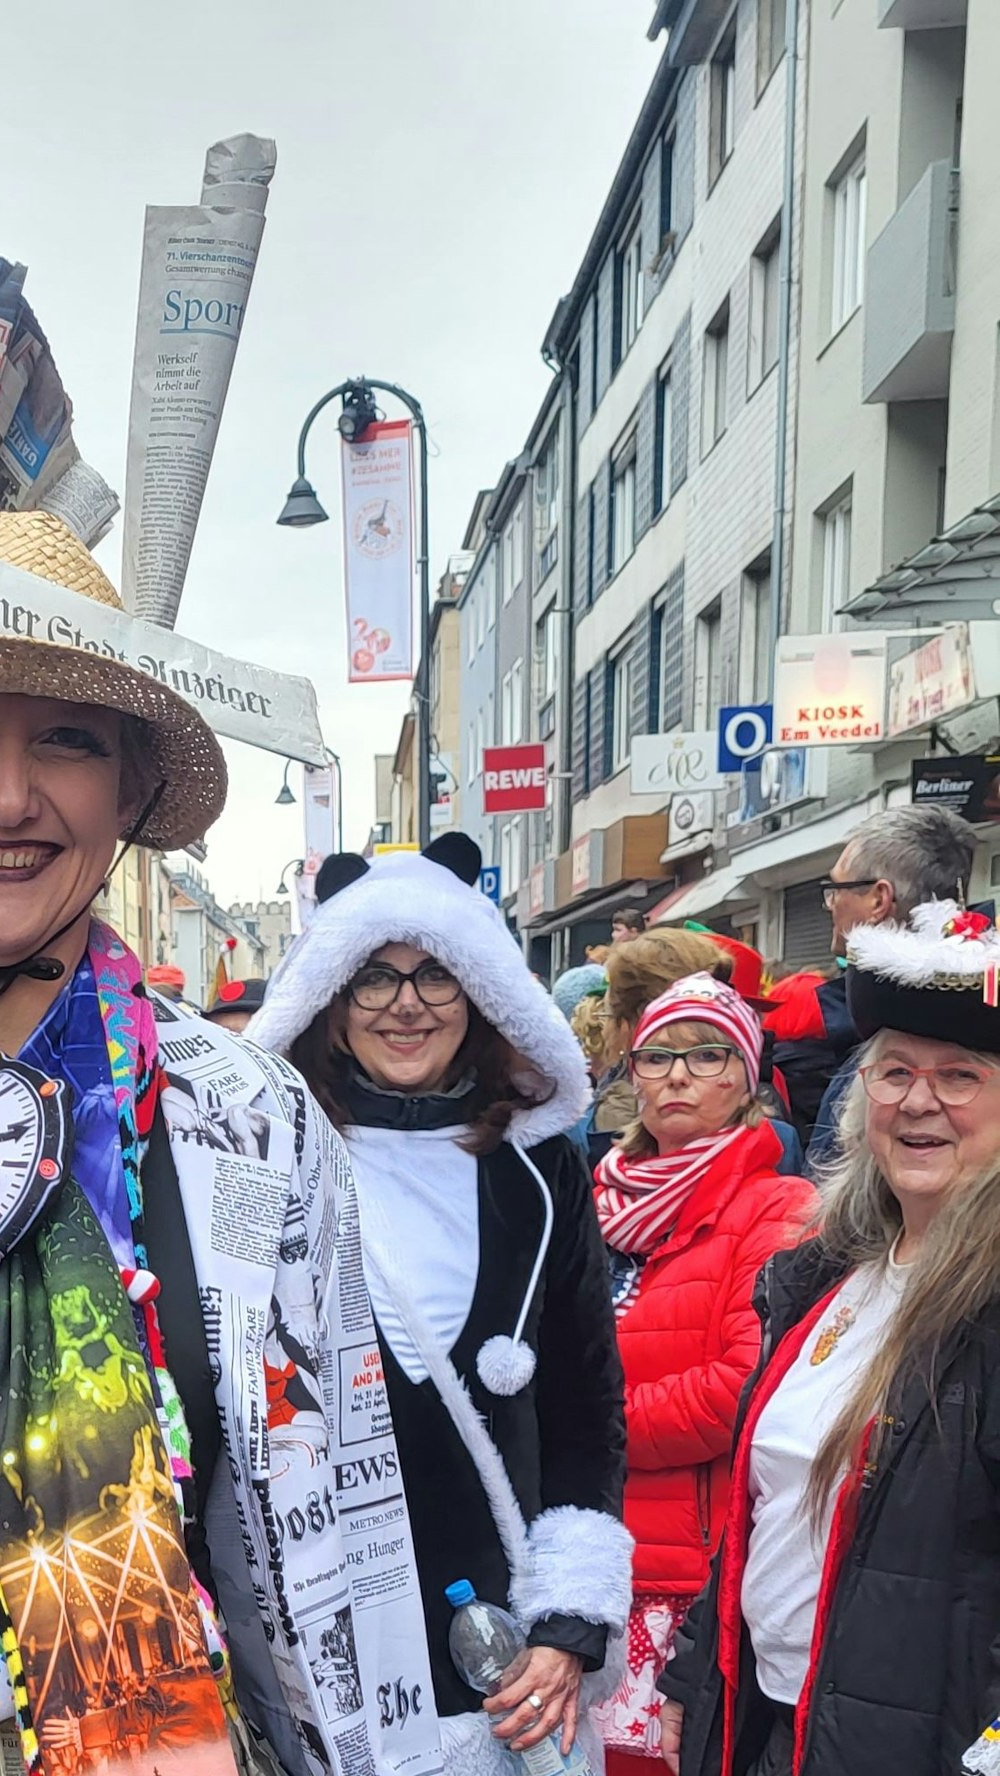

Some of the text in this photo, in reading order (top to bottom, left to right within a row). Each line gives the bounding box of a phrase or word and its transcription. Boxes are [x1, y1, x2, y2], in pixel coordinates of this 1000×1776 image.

[157, 352, 198, 366] Werkself
[155, 366, 201, 378] nimmt die
[154, 380, 201, 391] Arbeit auf
[137, 654, 273, 719] Anzeiger
[797, 704, 864, 722] KIOSK
[780, 722, 881, 742] Em Veedel
[484, 767, 546, 791] REWE
[209, 1072, 243, 1093] FARE
[352, 1370, 374, 1388] AND
[349, 1506, 405, 1532] METRO NEWS
[367, 1535, 405, 1561] Hunger
